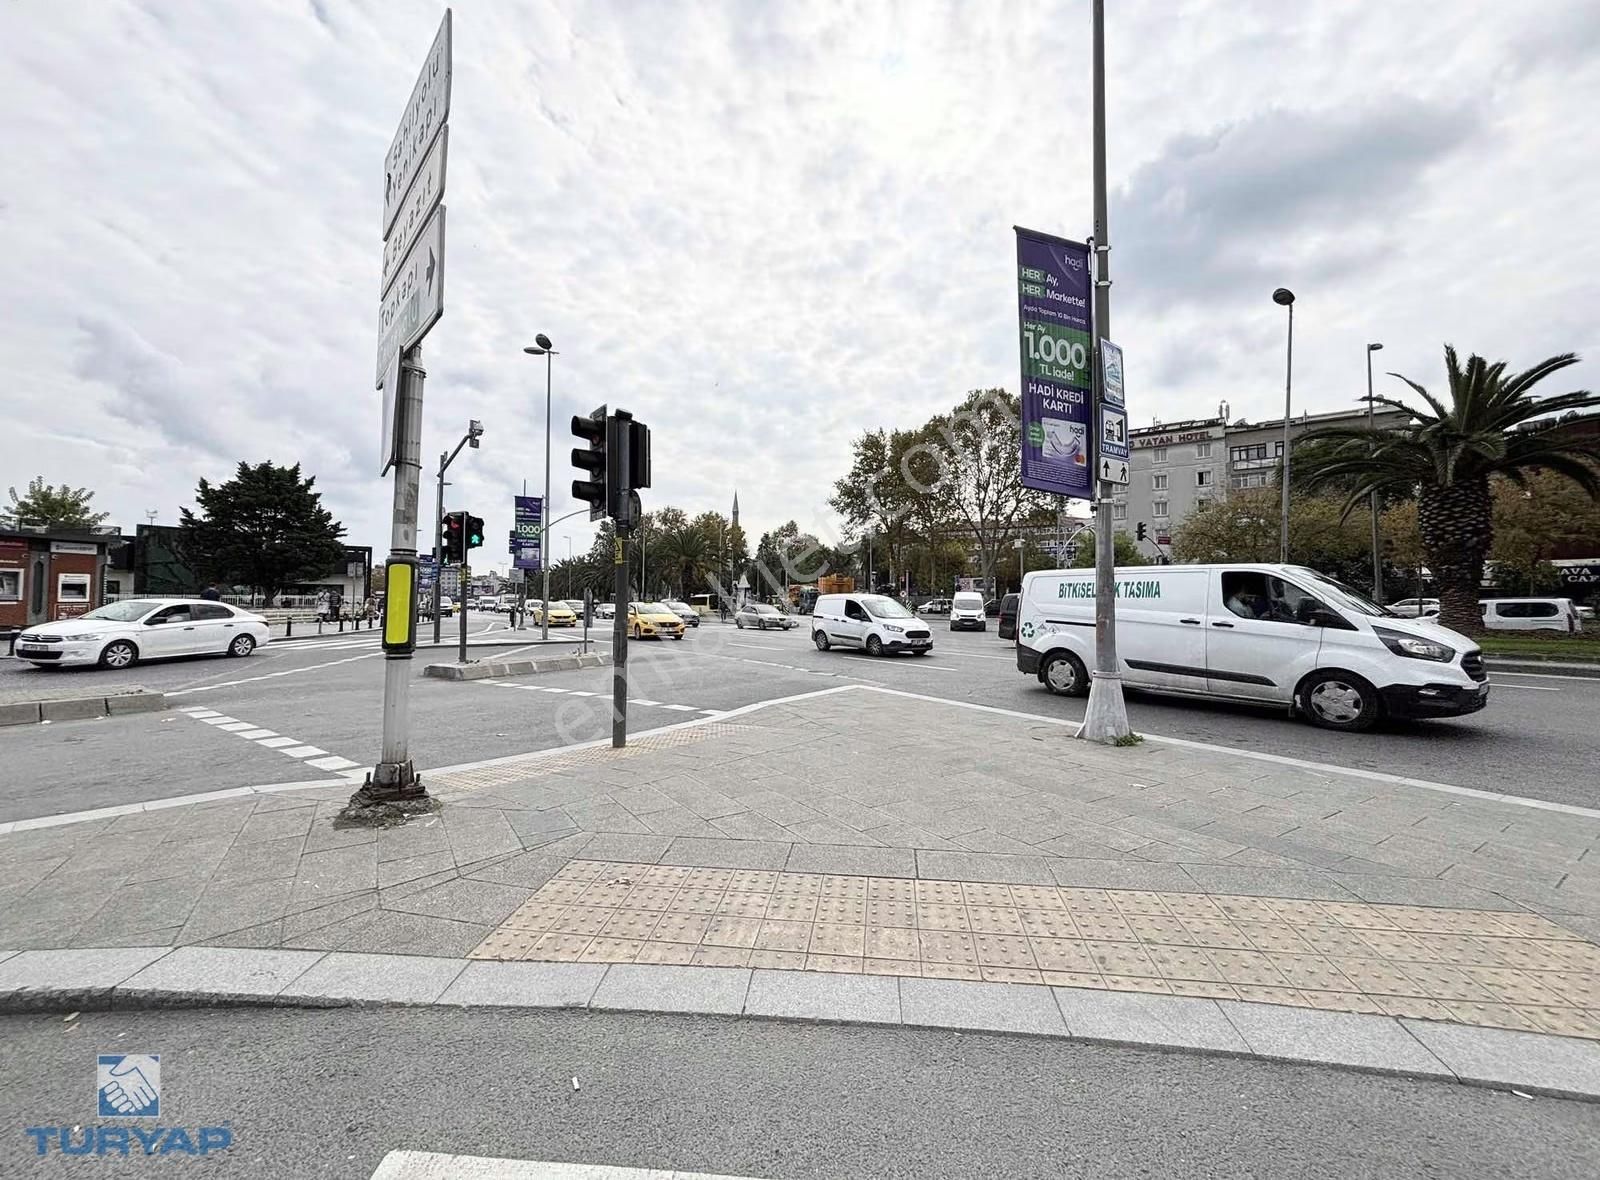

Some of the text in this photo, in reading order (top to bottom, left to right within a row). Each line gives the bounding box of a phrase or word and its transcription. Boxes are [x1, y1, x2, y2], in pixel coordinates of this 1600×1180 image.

[392, 174, 432, 262] Beyazıt
[1022, 267, 1059, 287] HER Ay,
[1022, 283, 1041, 296] HER
[380, 263, 419, 334] Topkapı
[1023, 321, 1046, 333] Her Ay
[1023, 330, 1086, 370] 1.000
[1039, 363, 1074, 381] TL iade!
[1028, 382, 1084, 404] HADİ KREDİ
[1042, 398, 1072, 414] KARTI
[1139, 434, 1173, 447] VATAN
[1178, 431, 1213, 443] HOTEL
[1101, 443, 1128, 457] TRAMVAY
[1567, 575, 1600, 583] CAF
